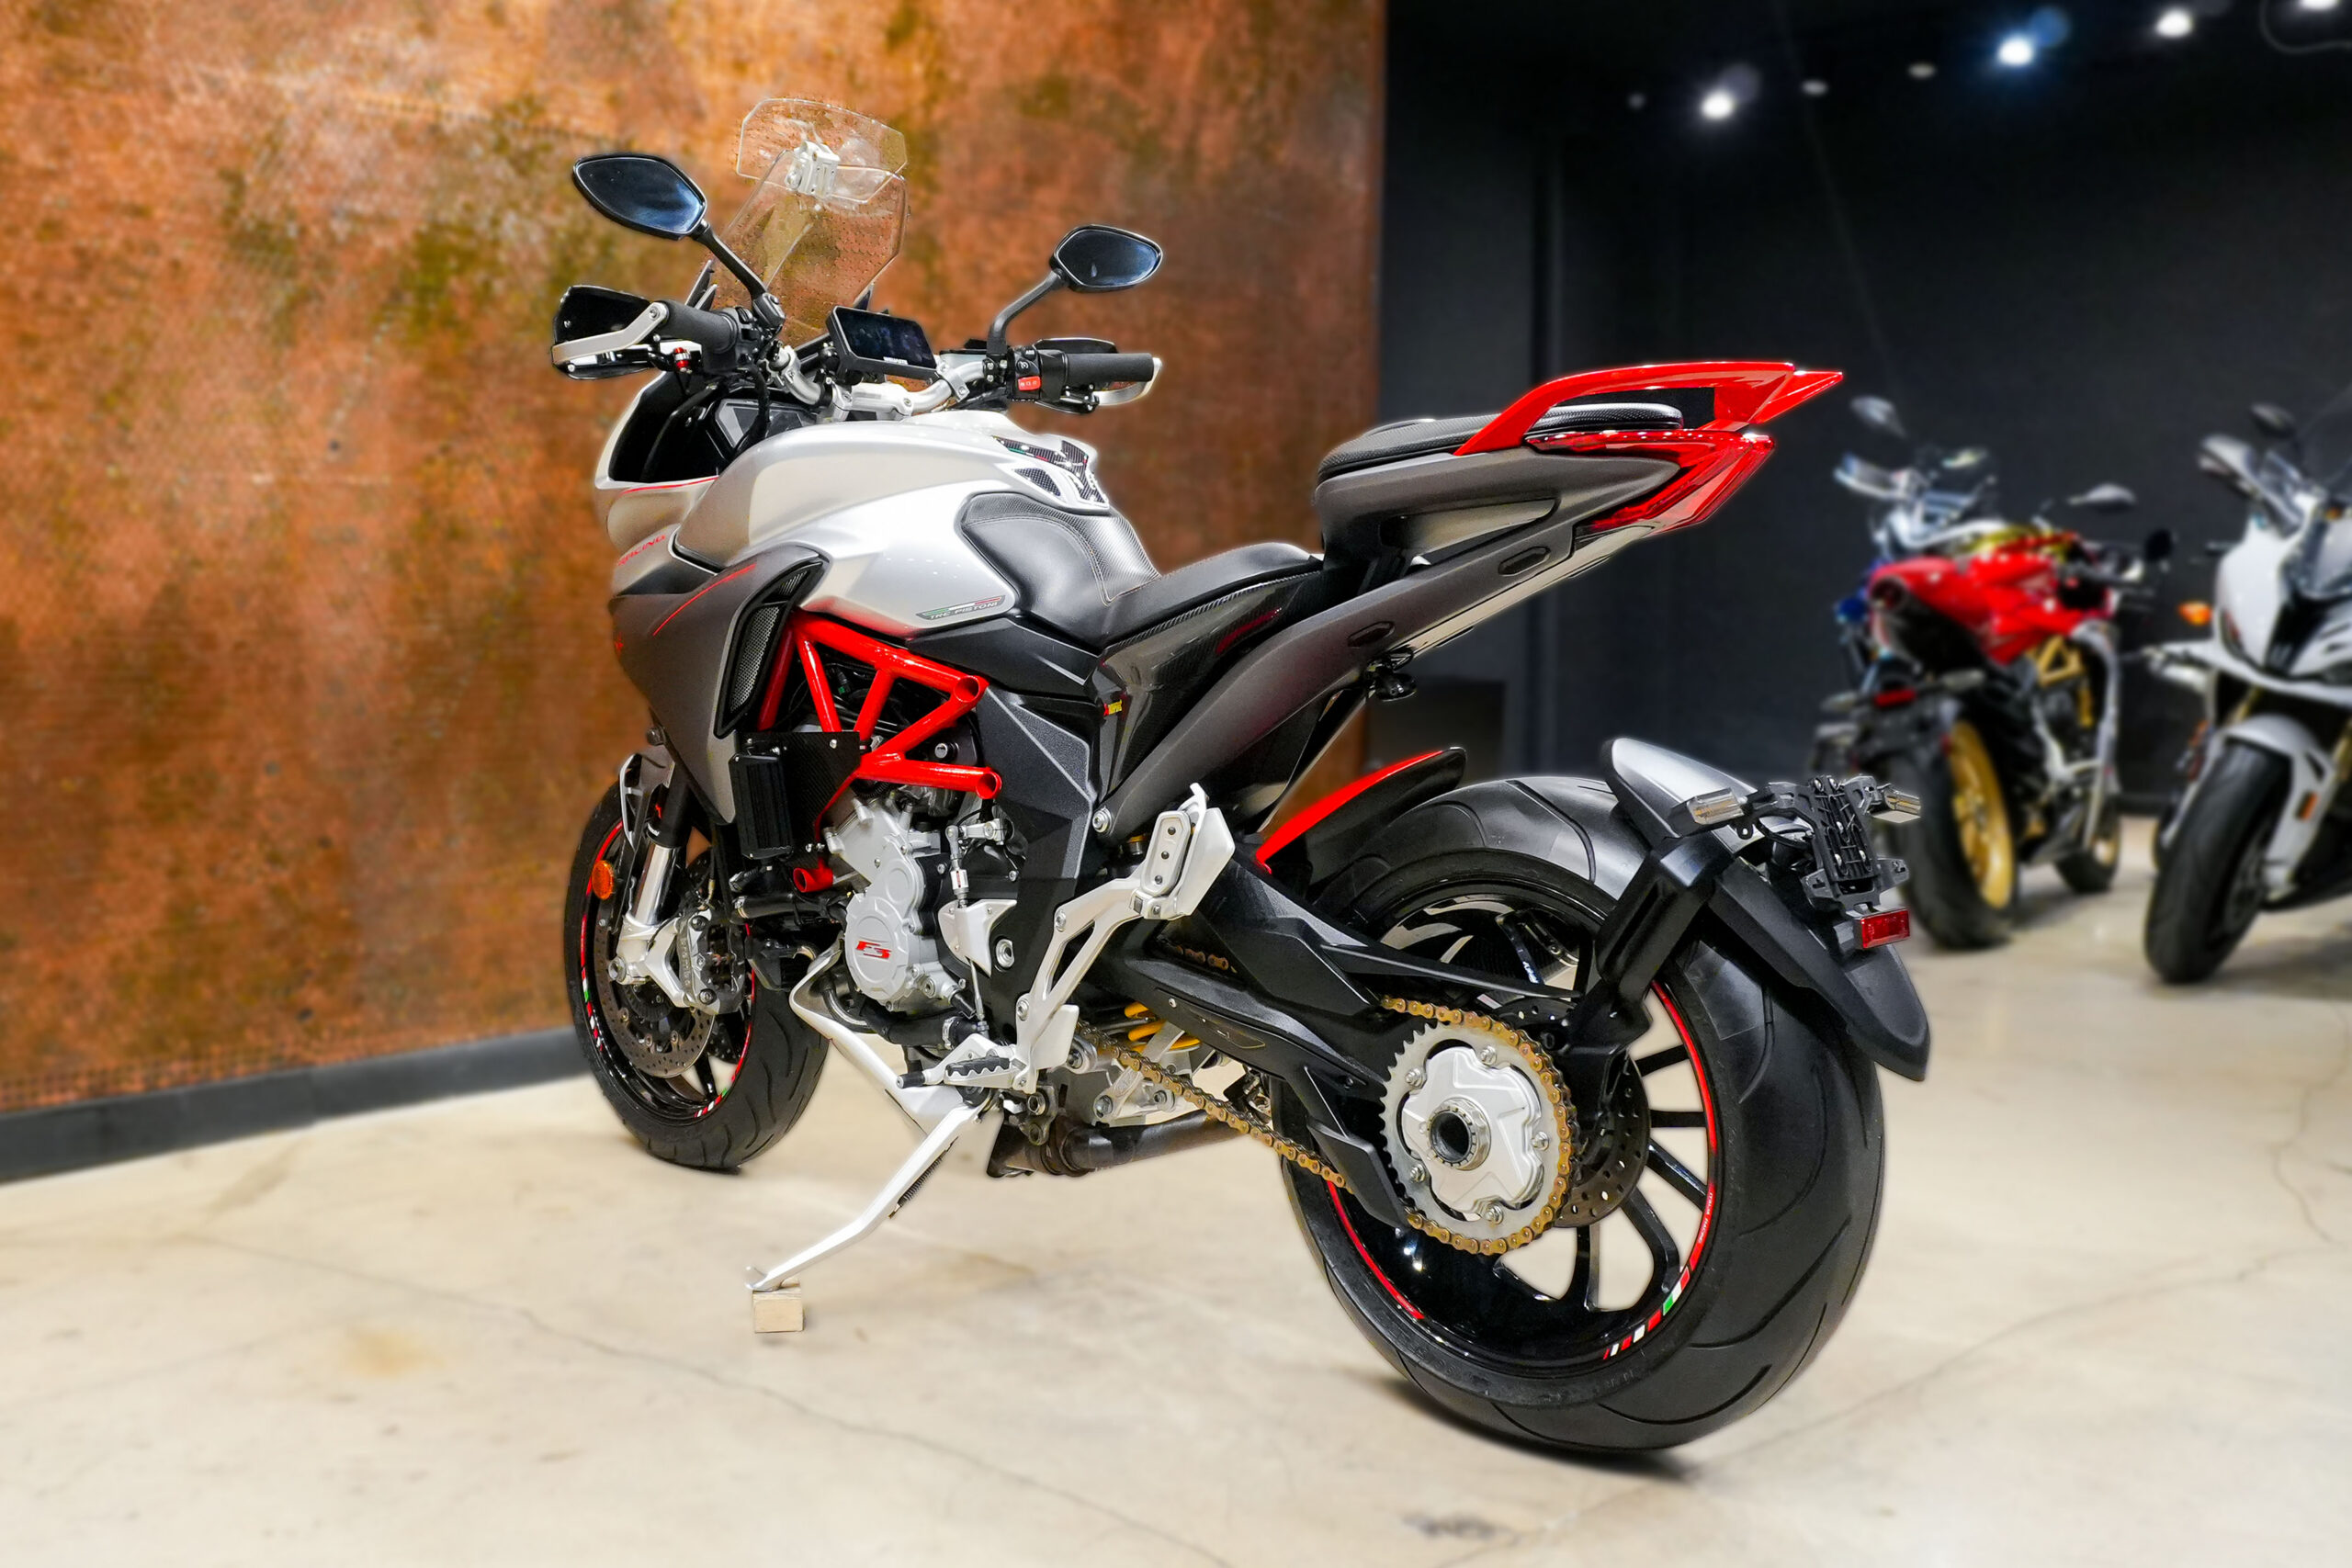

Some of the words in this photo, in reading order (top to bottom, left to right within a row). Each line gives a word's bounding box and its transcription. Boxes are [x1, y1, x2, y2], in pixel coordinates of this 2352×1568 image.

[930, 611, 951, 620] TRE
[955, 602, 998, 615] PISTONI
[855, 940, 893, 960] F3
